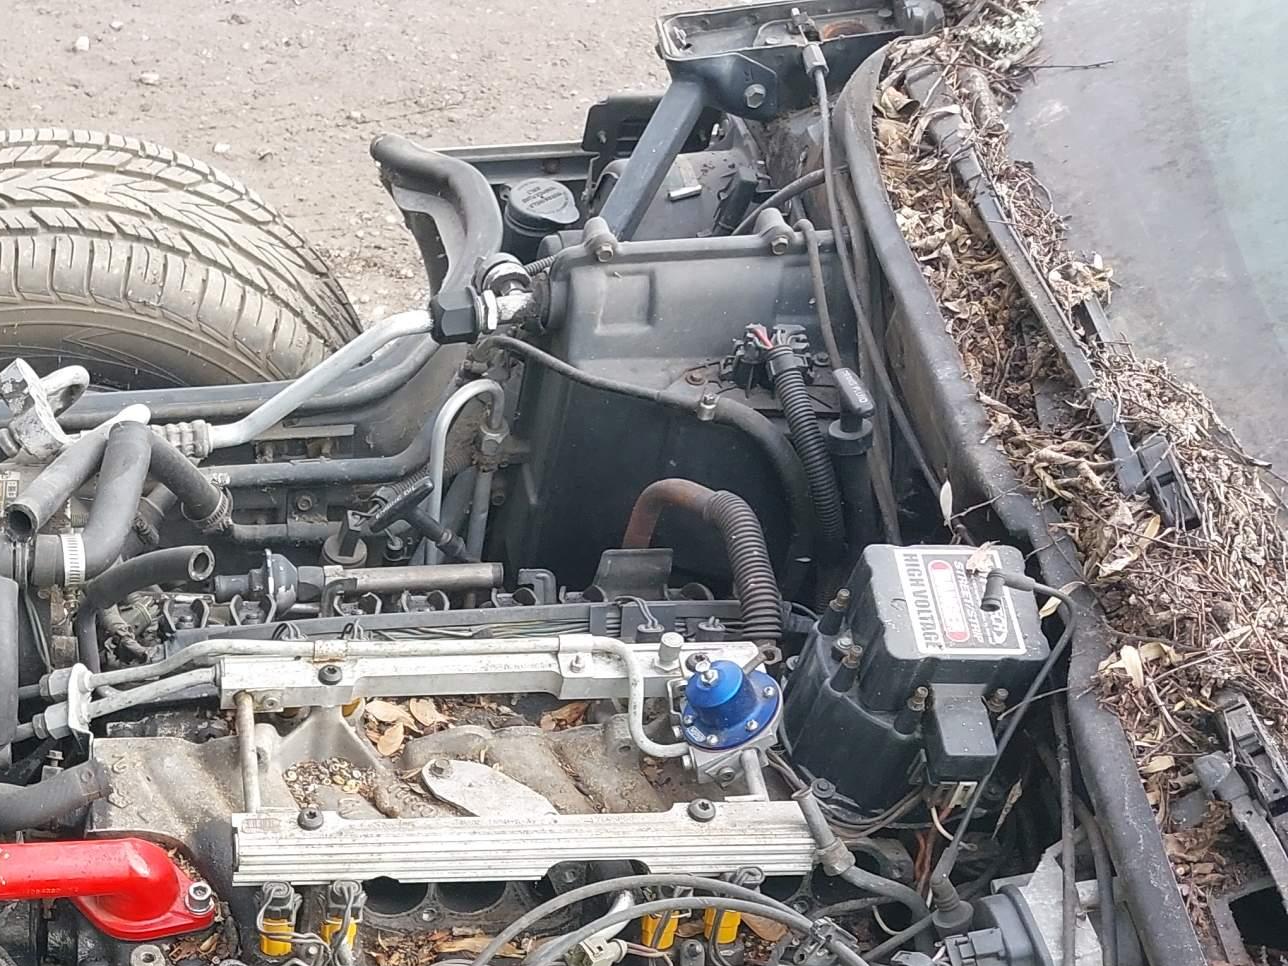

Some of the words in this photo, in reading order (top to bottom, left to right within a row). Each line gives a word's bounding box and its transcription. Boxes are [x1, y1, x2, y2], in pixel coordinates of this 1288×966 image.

[902, 553, 926, 588] HIGH
[912, 590, 941, 649] VOLTAGE
[953, 560, 985, 643] STREET/STRIP
